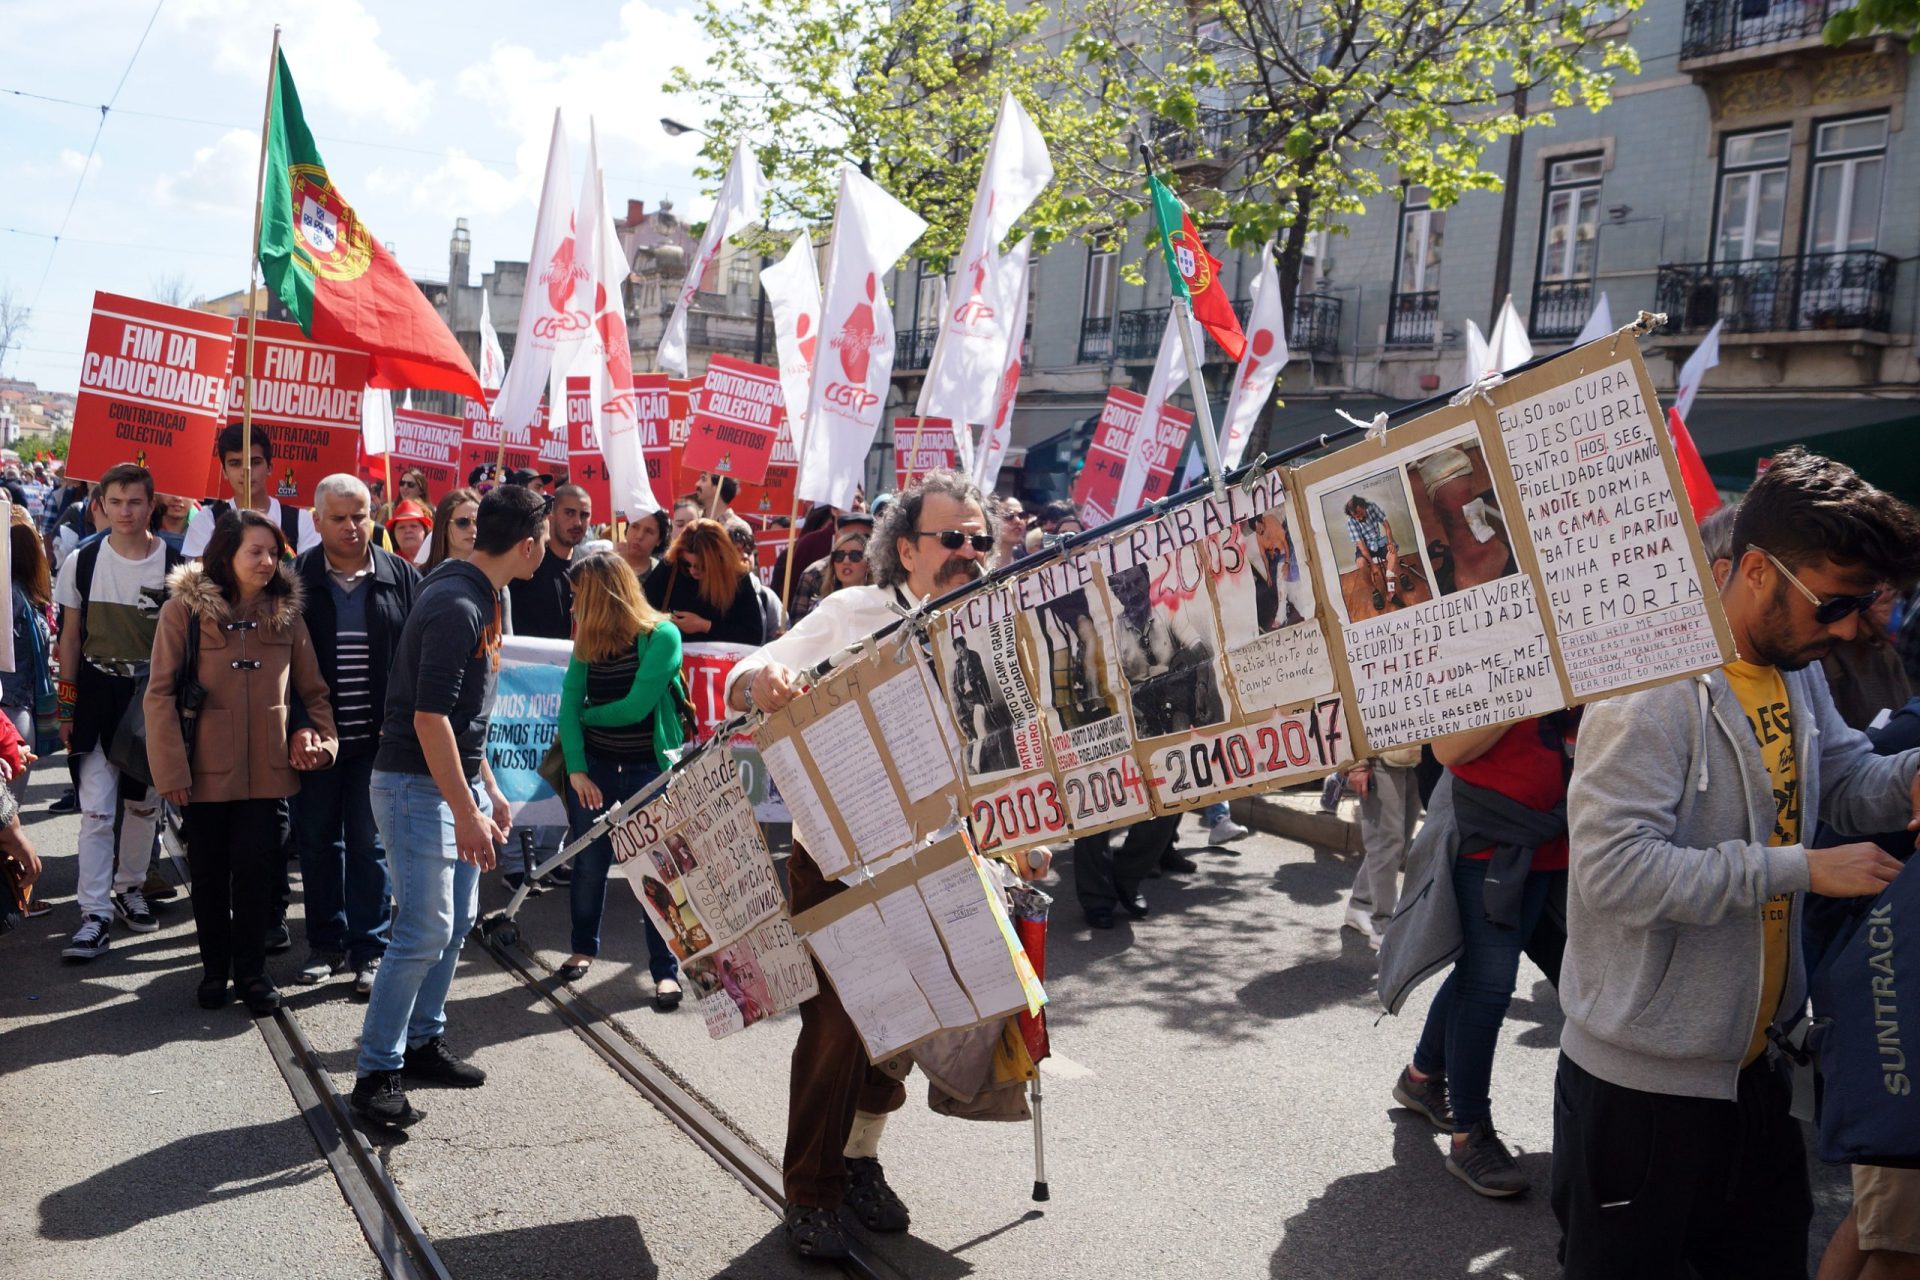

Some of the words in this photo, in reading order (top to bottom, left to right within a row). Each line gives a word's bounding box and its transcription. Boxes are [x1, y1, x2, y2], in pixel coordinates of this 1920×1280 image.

[121, 324, 164, 363] FIM
[166, 333, 197, 371] DA
[82, 352, 225, 411] CADUCIDADE!
[264, 346, 305, 381] FIM
[307, 351, 336, 385] DA
[708, 393, 772, 425] COLECTIVA
[825, 382, 879, 413] CGTP
[1524, 403, 1543, 424] SO
[1549, 399, 1570, 416] DOU
[1575, 371, 1629, 405] CURA
[109, 403, 187, 432] CONTRATAÇÃO
[394, 421, 460, 447] CONTRATAÇÃO
[116, 423, 173, 447] COLECTIVA
[399, 440, 450, 460] COLECTIVA
[716, 424, 767, 450] DIREITOS!
[1508, 439, 1517, 460] E
[271, 443, 318, 463] OLECTIVA
[1511, 450, 1569, 482] DENTRO
[1528, 508, 1537, 521] A
[1540, 490, 1580, 519] NOITE
[1533, 526, 1552, 543] NA
[1558, 506, 1610, 536] CAMA
[1614, 489, 1674, 519] ALGEM
[1545, 535, 1599, 564] BATEU
[1622, 509, 1679, 540] PARTIU
[1158, 525, 1246, 594] 2003
[1545, 558, 1599, 586] MINHA
[1611, 537, 1674, 567] PERNA
[1551, 590, 1571, 607] EU
[1584, 573, 1630, 598] PER
[1654, 557, 1687, 580] DI
[1344, 629, 1359, 646] TO
[1365, 622, 1391, 642] HAV
[1396, 619, 1410, 632] AN
[1415, 589, 1478, 626] ACCIDENT
[1481, 579, 1530, 608] WORK
[1557, 578, 1702, 632] MEMORIA
[1636, 617, 1654, 631] ME
[1662, 611, 1677, 622] TO
[1680, 602, 1704, 619] PUT
[1413, 598, 1535, 646] FIDELIDADI
[1306, 642, 1319, 656] do
[1564, 646, 1596, 661] EVERY
[1567, 653, 1618, 671] TOMORROW
[1624, 641, 1666, 656] MORNING
[993, 652, 1010, 686] CAMPO
[1276, 660, 1314, 682] Grande
[1356, 687, 1365, 704] O
[1371, 671, 1423, 702] IRMÃO
[1514, 633, 1545, 659] MET
[1003, 686, 1015, 700] DO
[1008, 659, 1037, 720] FIDELIDADE
[1361, 700, 1397, 721] TUDU
[1405, 686, 1440, 712] ESTE
[1445, 682, 1473, 700] PELA
[1488, 655, 1551, 692] INTERNET
[1366, 718, 1415, 739] AMANHA
[1442, 698, 1488, 720] RASEBE
[1495, 686, 1533, 707] MEDU
[1408, 721, 1460, 742] FEZEREN
[491, 747, 537, 771] NOSSO
[972, 781, 1066, 851] 2003
[1867, 902, 1911, 1096] SUNTRACK
